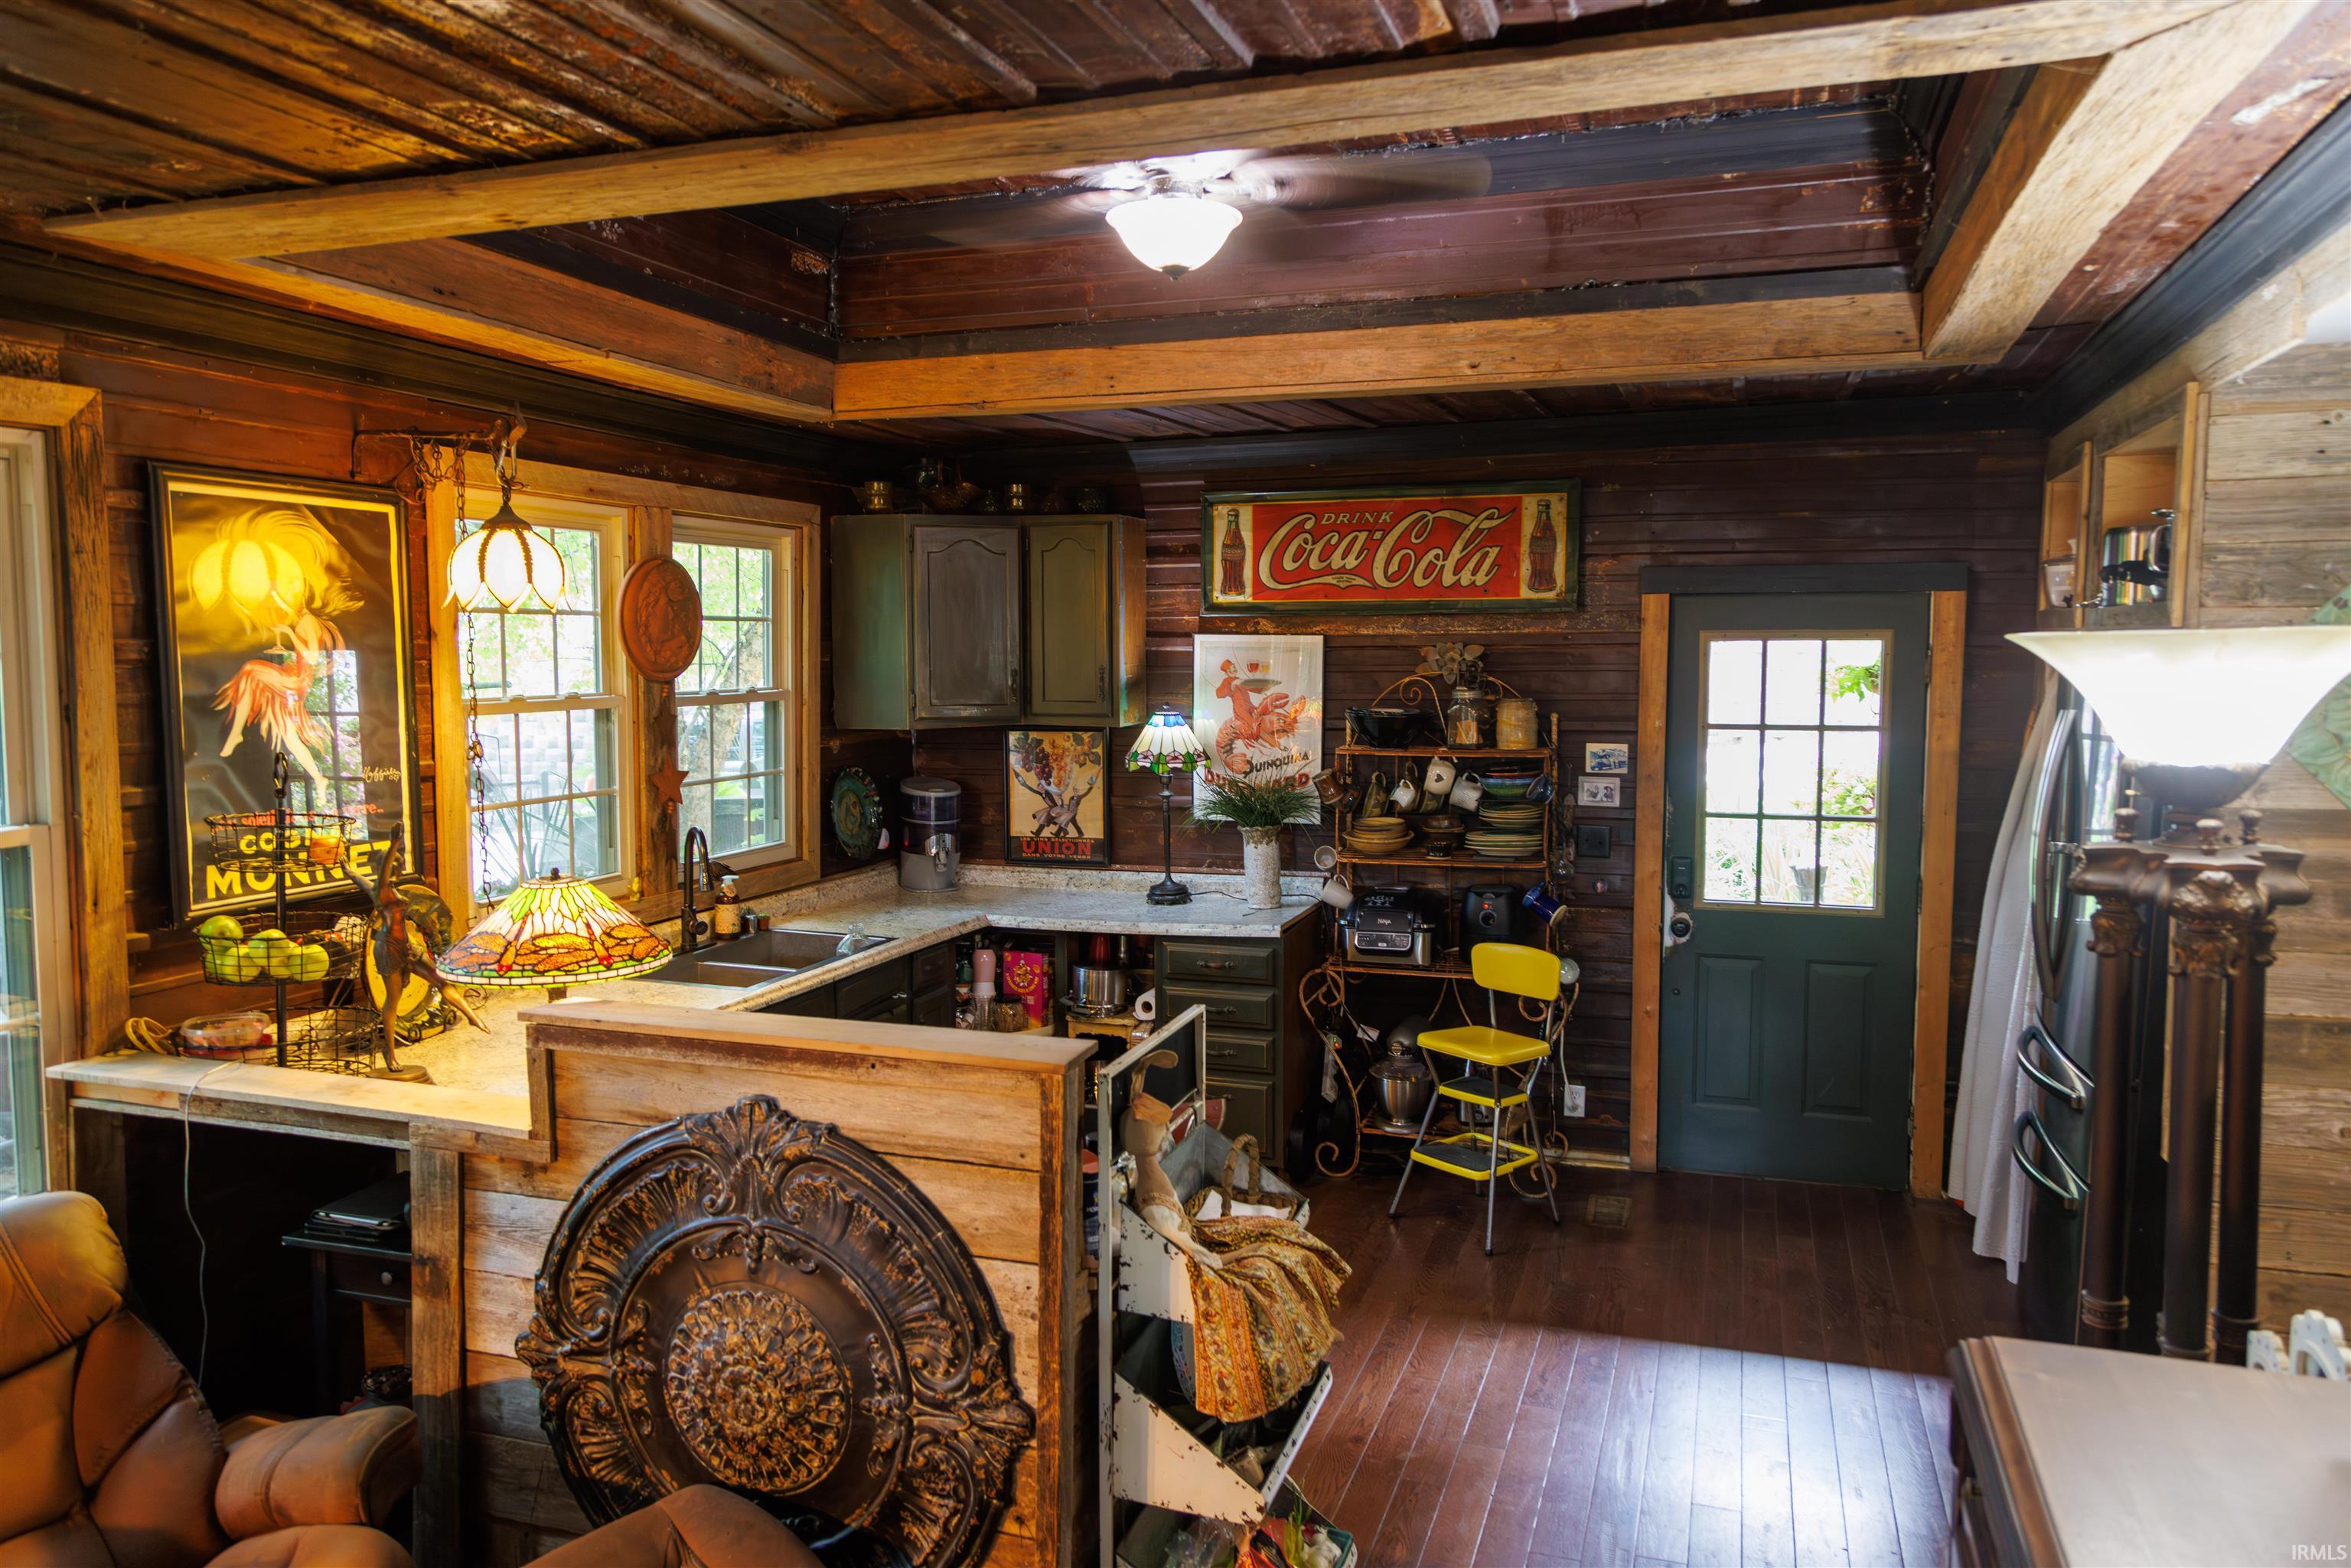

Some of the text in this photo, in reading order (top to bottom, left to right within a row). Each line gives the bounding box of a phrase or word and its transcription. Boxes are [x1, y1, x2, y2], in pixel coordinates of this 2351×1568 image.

[1320, 510, 1394, 526] DRINK
[1257, 506, 1518, 591] Coca-Cola
[1022, 839, 1091, 855] UNION
